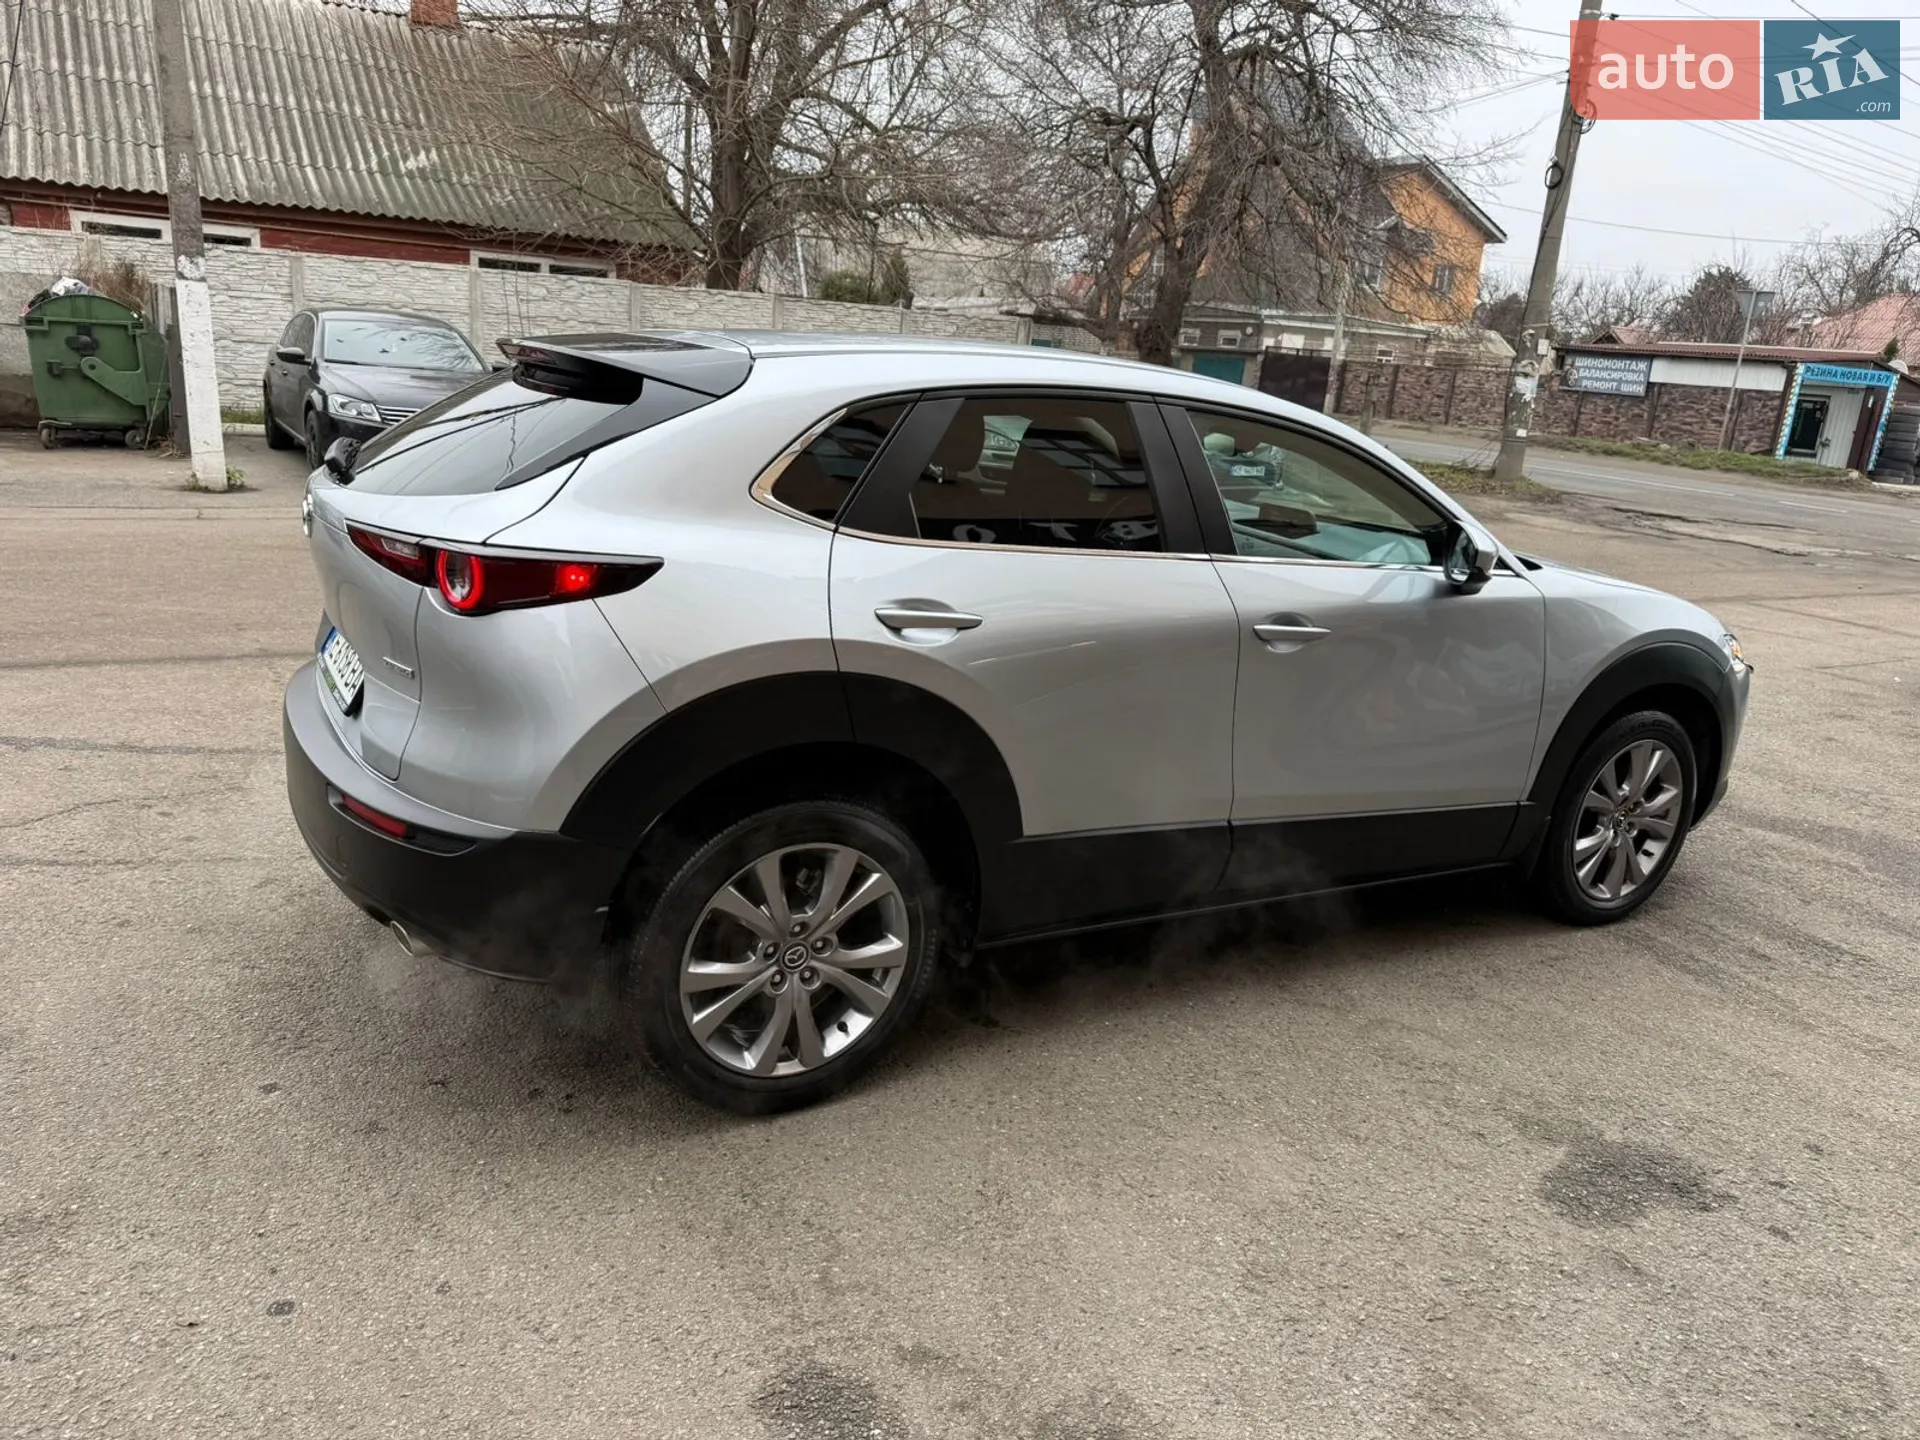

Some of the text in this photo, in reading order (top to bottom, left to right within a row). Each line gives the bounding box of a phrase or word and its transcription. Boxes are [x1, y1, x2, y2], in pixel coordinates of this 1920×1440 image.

[1575, 357, 1648, 371] ШИНОМОНТАЖ
[1579, 368, 1645, 382] БАЛАНСИРОВКА
[1805, 365, 1838, 378] РЕЗИНА
[1840, 370, 1868, 381] НОВАЯ
[1581, 380, 1644, 393] РЕМОНТ ШИН
